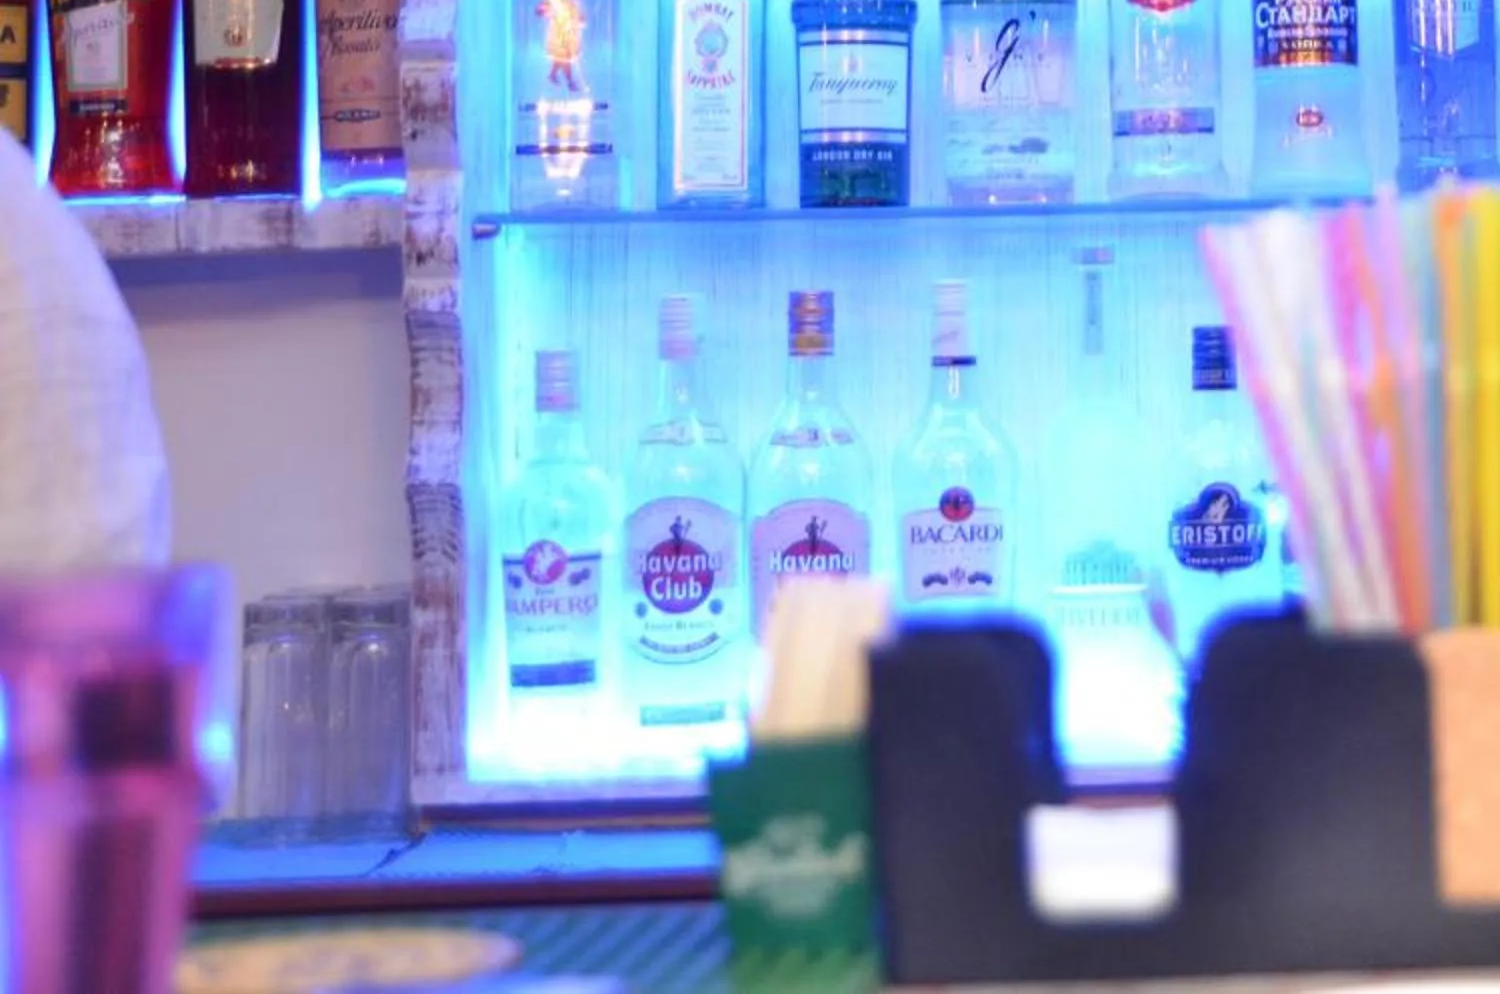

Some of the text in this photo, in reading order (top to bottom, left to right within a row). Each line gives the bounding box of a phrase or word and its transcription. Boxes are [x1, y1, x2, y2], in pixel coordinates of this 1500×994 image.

[807, 72, 898, 97] Tanqueray
[910, 523, 1004, 545] BACARDI
[638, 551, 722, 573] Havana
[769, 550, 856, 572] Havana
[650, 576, 702, 601] Club
